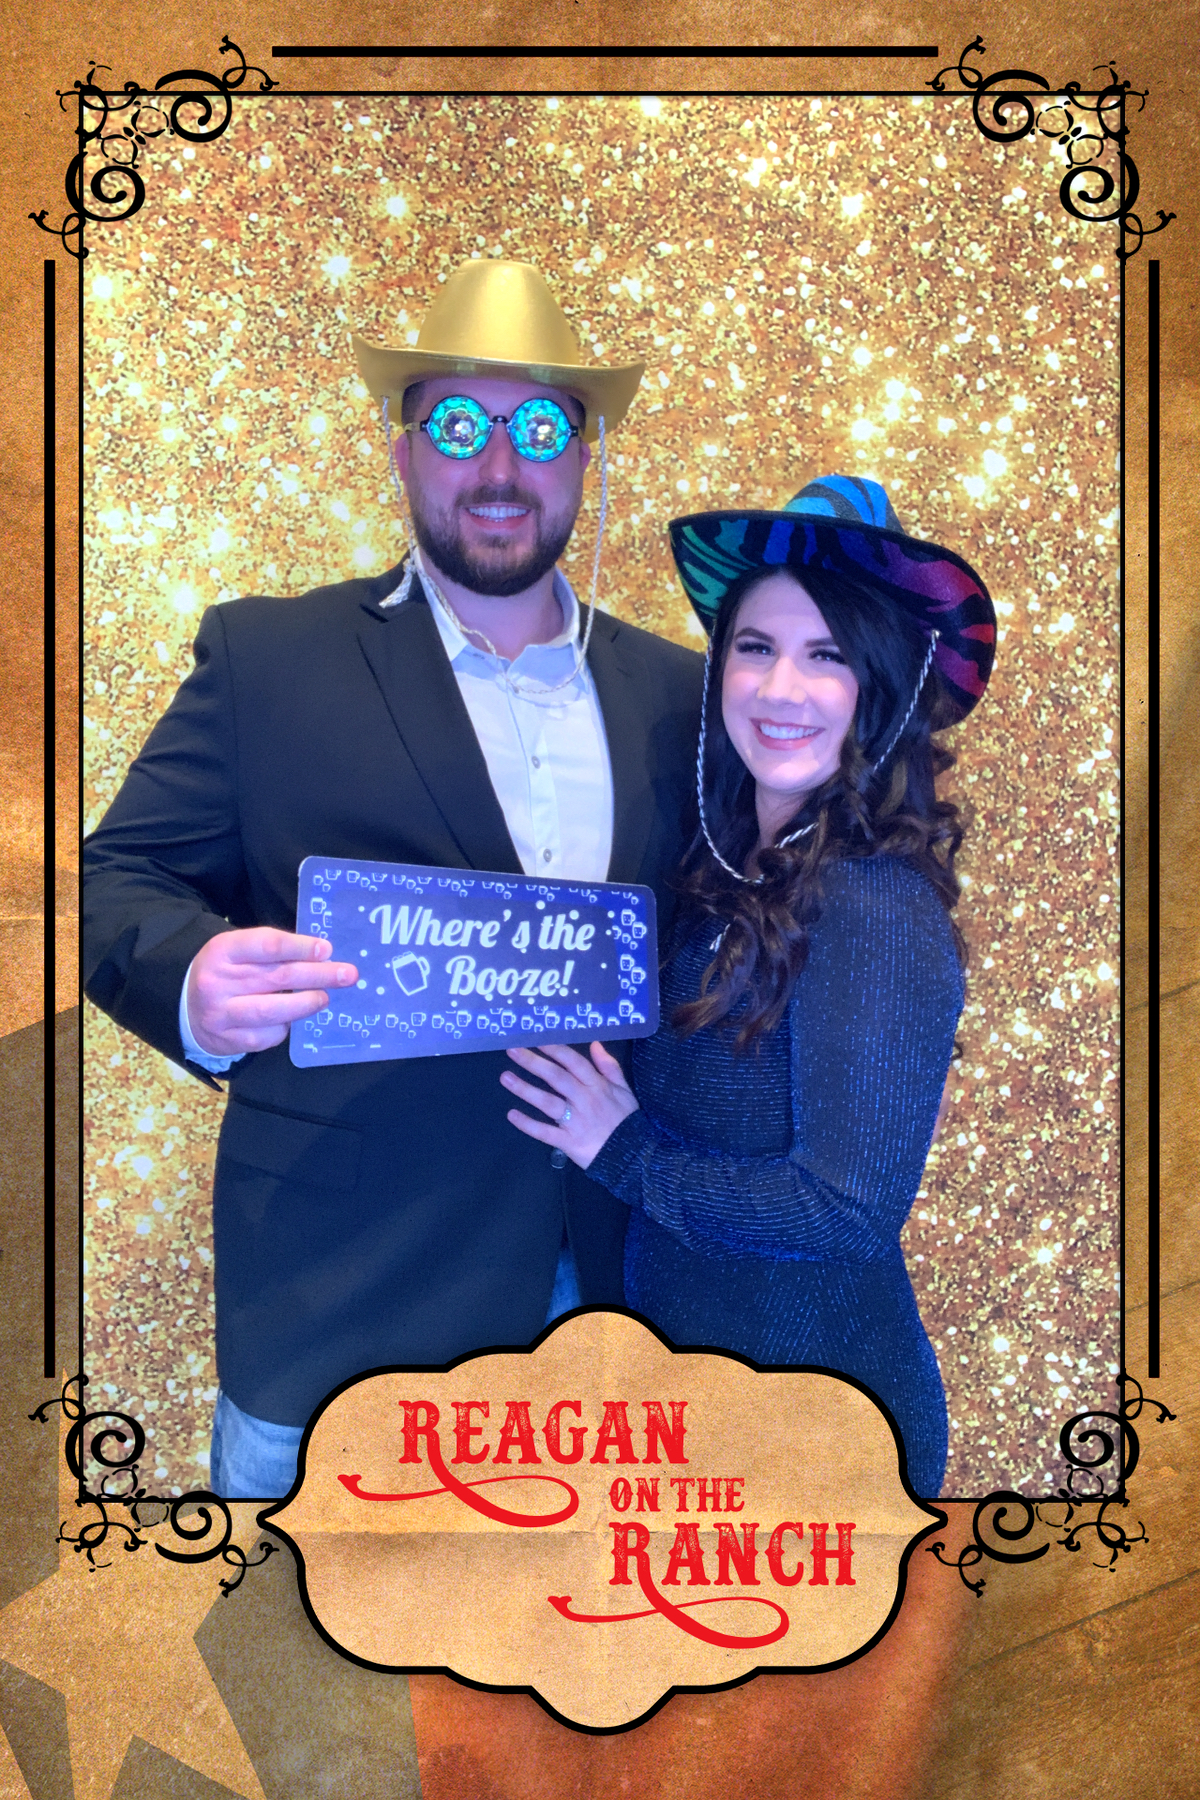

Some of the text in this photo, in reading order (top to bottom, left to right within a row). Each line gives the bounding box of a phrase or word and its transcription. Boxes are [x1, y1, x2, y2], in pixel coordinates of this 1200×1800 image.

[369, 904, 596, 951] Where's the
[445, 954, 575, 997] Booze!
